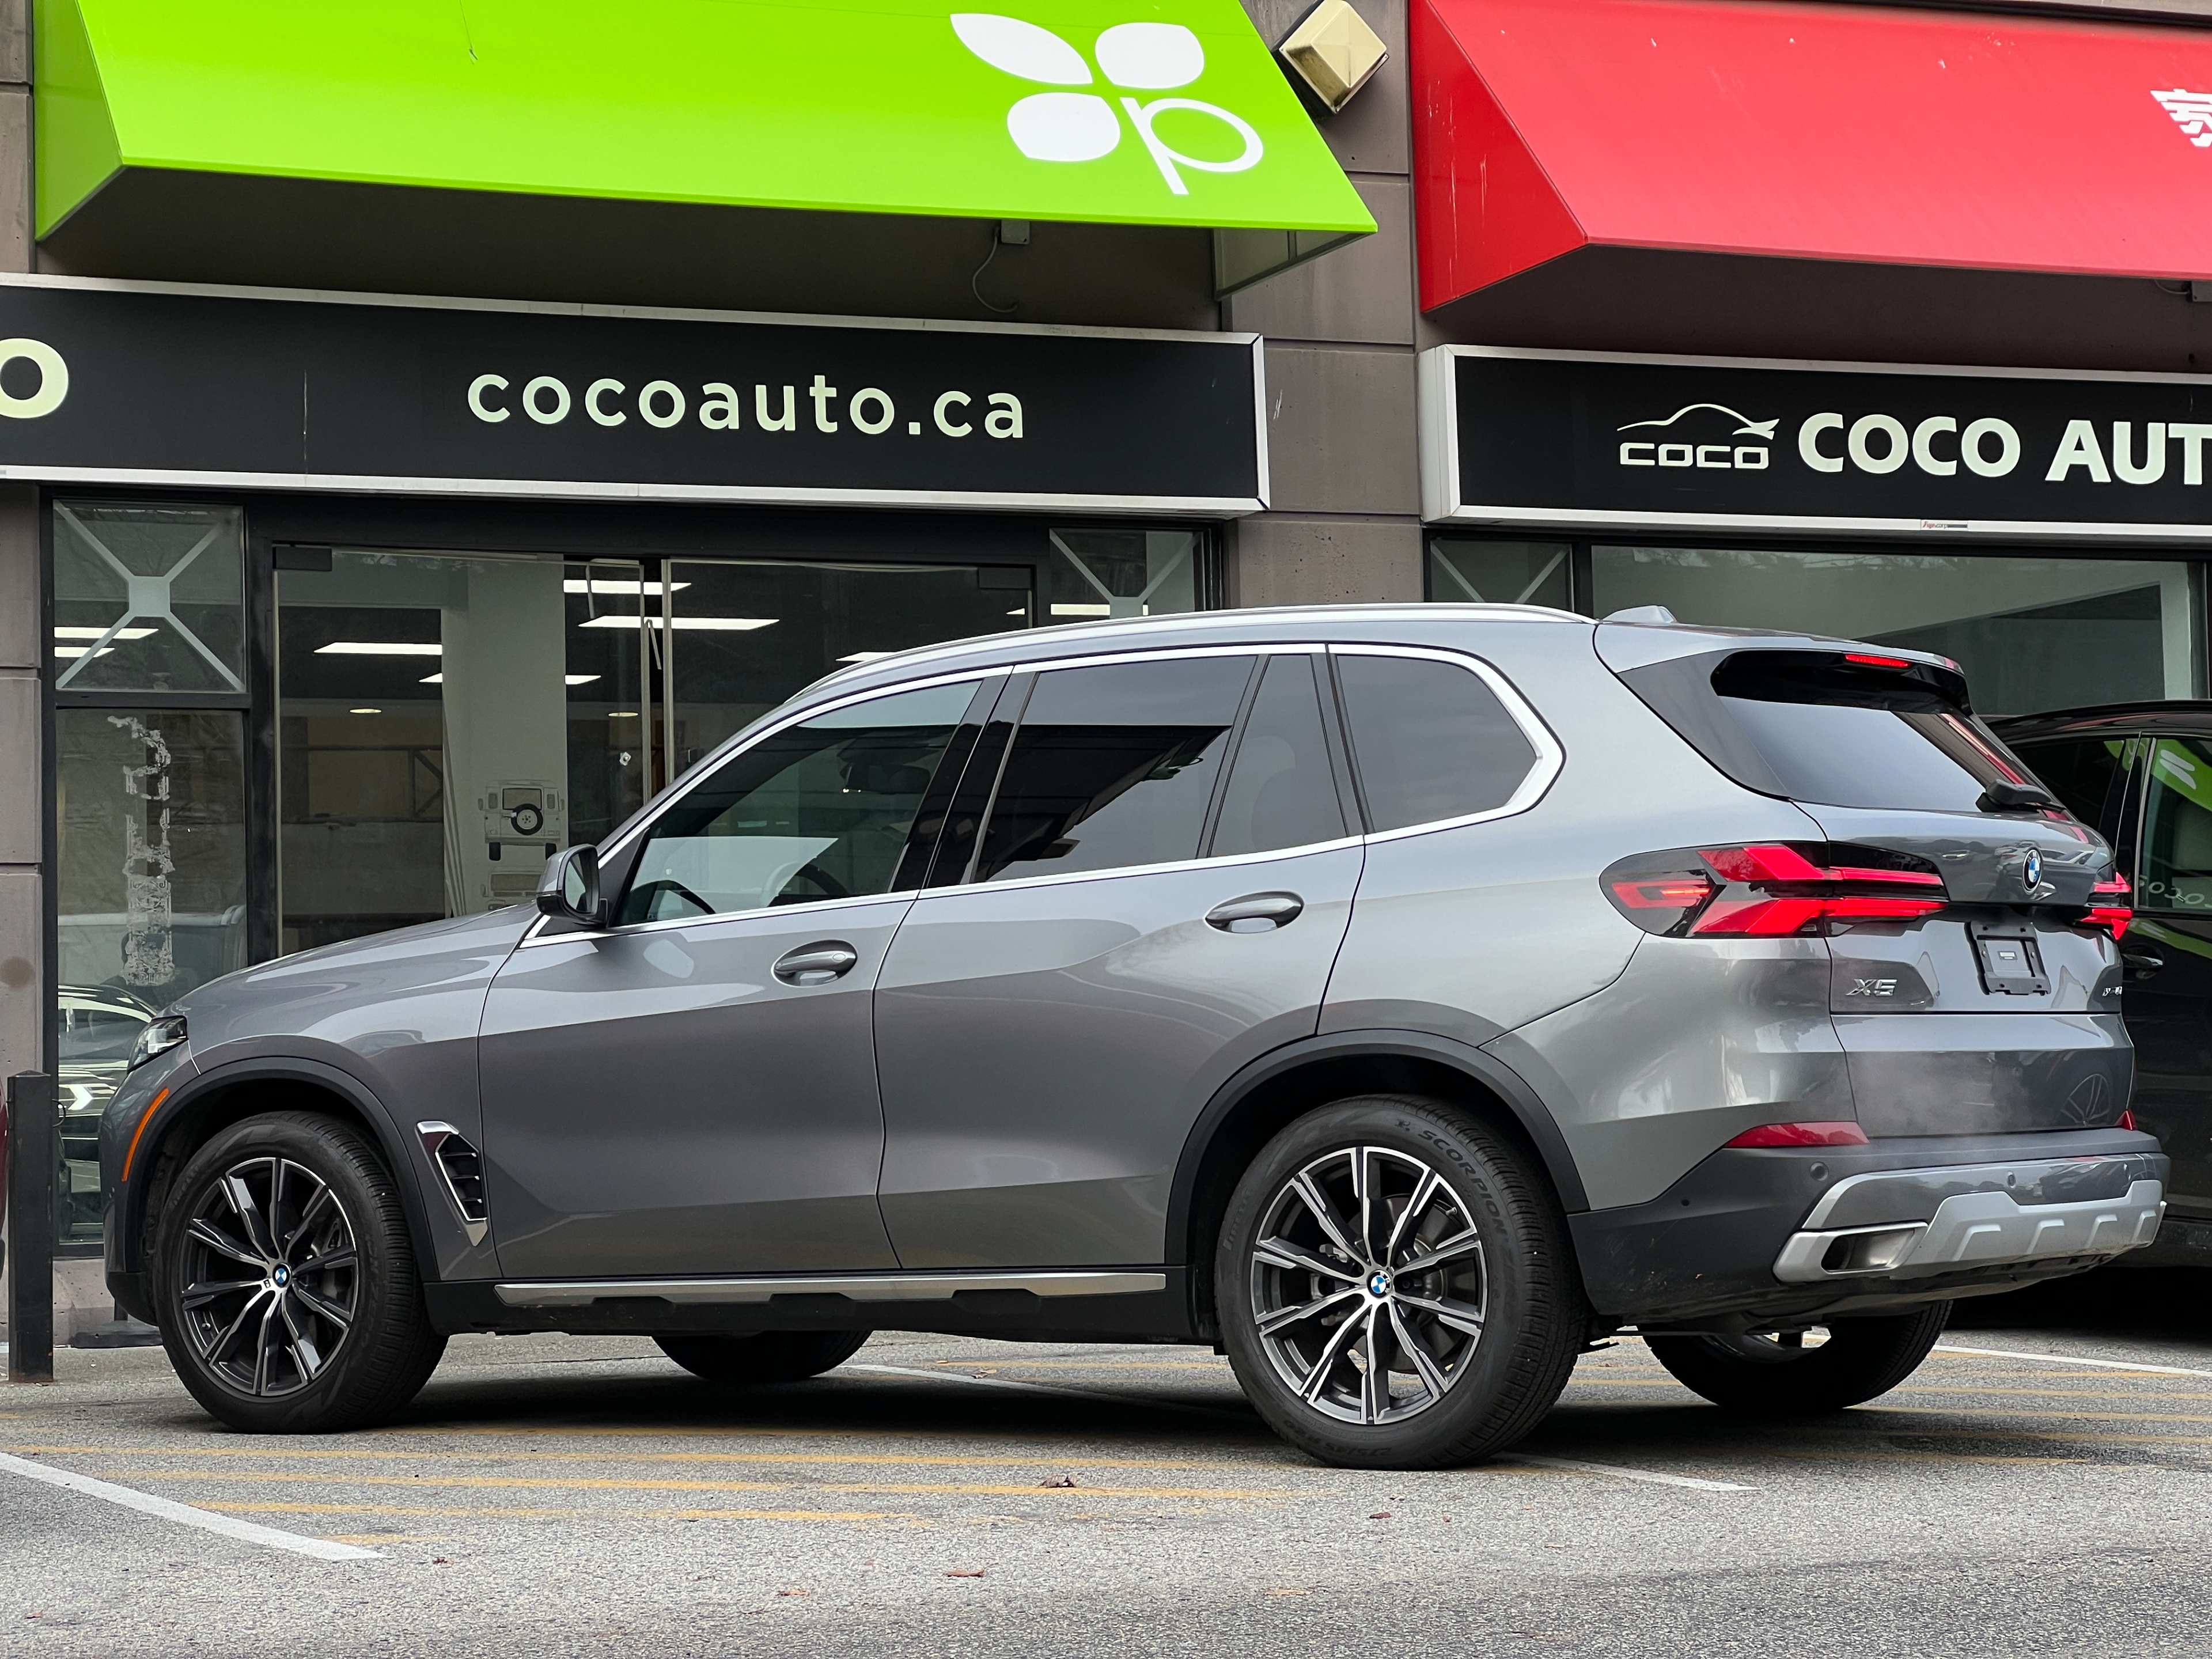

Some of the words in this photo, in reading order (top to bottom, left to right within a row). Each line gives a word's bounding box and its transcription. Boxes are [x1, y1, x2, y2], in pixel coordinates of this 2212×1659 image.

[468, 374, 1024, 439] cocoauto.ca
[1798, 412, 2021, 478] COCO
[2045, 419, 2212, 486] AUT
[1846, 979, 1897, 997] X5
[1418, 1129, 1508, 1235] SCORPION
